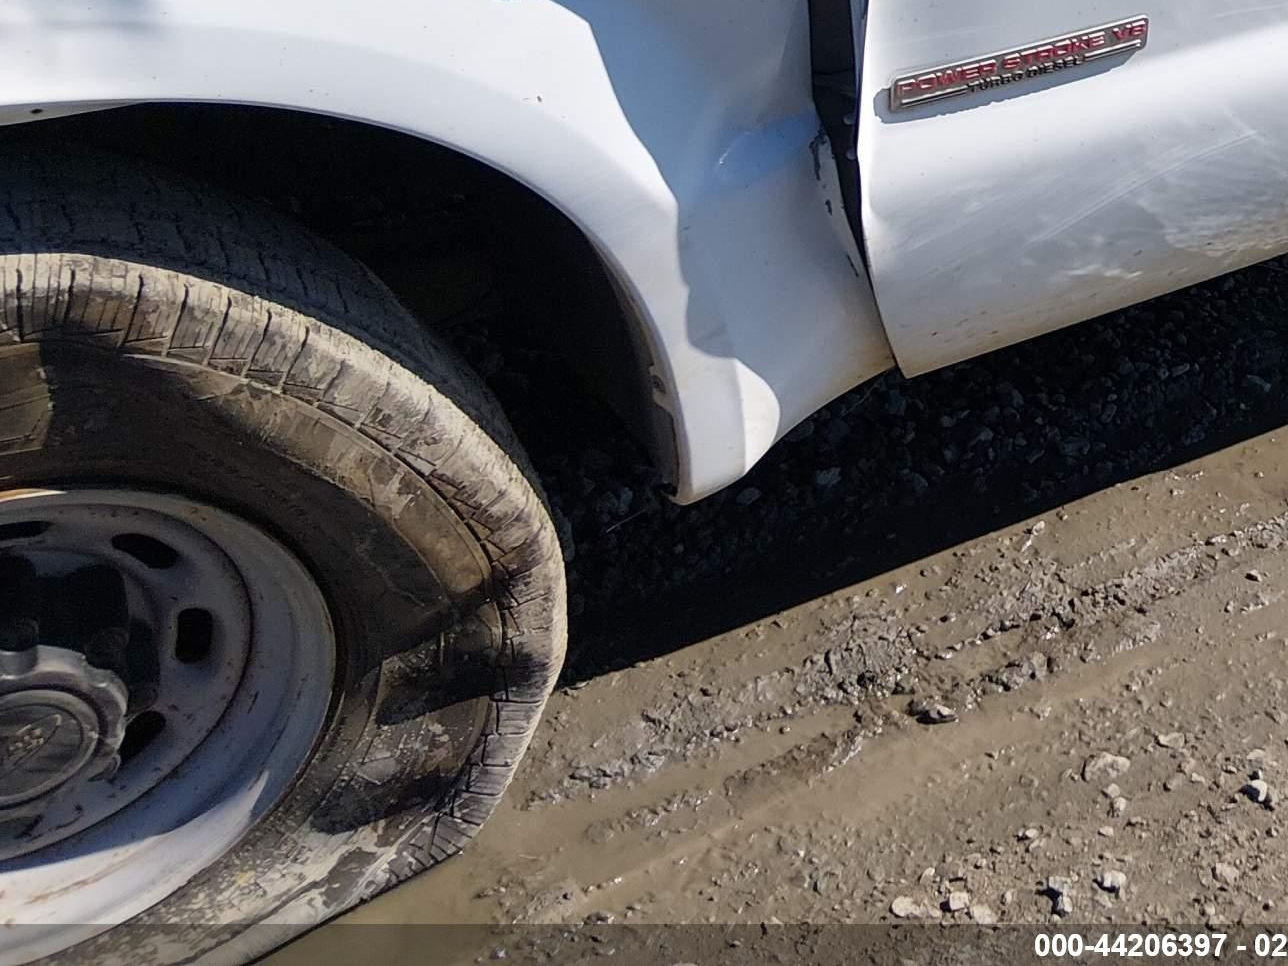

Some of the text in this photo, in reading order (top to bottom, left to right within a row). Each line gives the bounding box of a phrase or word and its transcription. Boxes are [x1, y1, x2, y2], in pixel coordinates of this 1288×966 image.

[897, 20, 1147, 92] POWER STROKE V8
[967, 54, 1085, 93] TURBO DIESEL
